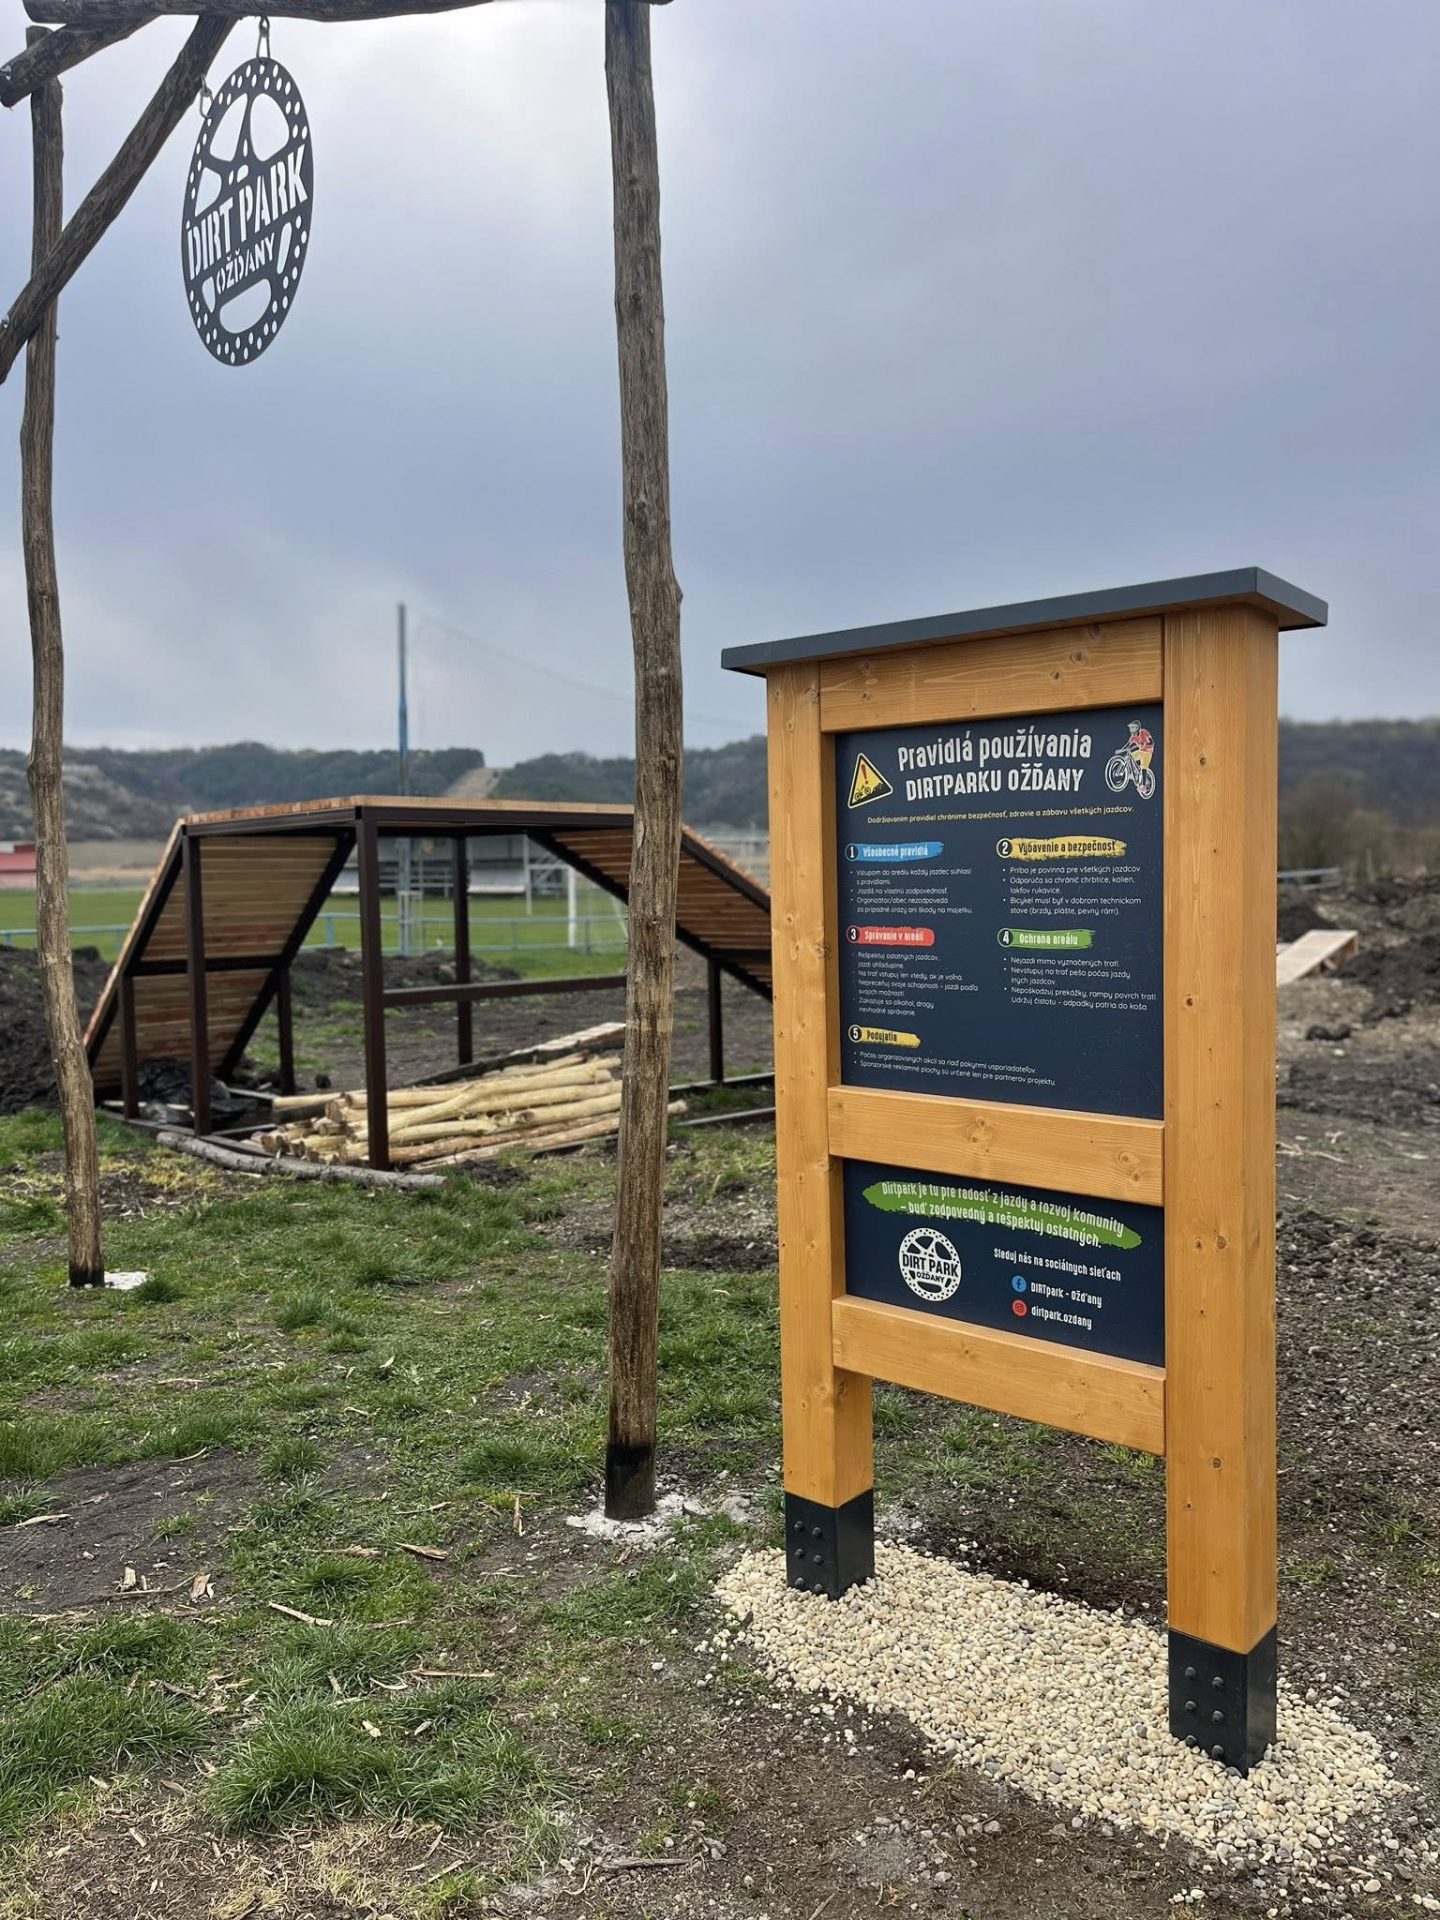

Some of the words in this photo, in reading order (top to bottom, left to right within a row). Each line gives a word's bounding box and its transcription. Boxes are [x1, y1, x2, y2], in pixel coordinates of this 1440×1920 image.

[187, 197, 233, 280] DIRT
[239, 144, 308, 242] PARK
[216, 232, 275, 294] OŽĎANY
[898, 730, 972, 772] Pravidlá
[980, 725, 1092, 768] používania
[906, 770, 1001, 801] DIRTPARKU
[1008, 762, 1084, 791] OŽĎANY
[937, 812, 966, 820] chránime
[1070, 807, 1102, 815] všetkých
[1103, 806, 1134, 814] jazdcov.
[850, 847, 854, 858] 1
[900, 844, 928, 858] pravidlá
[1002, 842, 1008, 854] 2
[1061, 844, 1065, 852] a
[1068, 840, 1115, 854] bezpečnosť
[1030, 867, 1036, 875] je
[1010, 897, 1033, 905] Bicykel
[1078, 907, 1099, 915] pevný
[851, 929, 856, 940] 3
[1003, 931, 1009, 943] 4
[1020, 933, 1050, 944] Ochrana
[1053, 933, 1078, 945] areálu
[1058, 959, 1102, 967] vyznačených
[1011, 967, 1043, 975] Nevstupuj
[1111, 970, 1130, 979] jazdy
[1011, 987, 1053, 996] Nepoškodzuj
[1063, 1000, 1093, 1009] odpadky
[853, 1028, 858, 1039] 5
[867, 1030, 897, 1043] Podujatia
[960, 1060, 987, 1069] pokynmi
[921, 1066, 941, 1075] plochy
[950, 1069, 971, 1077] určené
[994, 1073, 1026, 1082] partnerov
[1027, 1076, 1056, 1086] projektu.
[882, 1182, 917, 1198] Dirtpark
[918, 1182, 927, 1198] je
[929, 1184, 938, 1196] tu
[941, 1186, 956, 1200] pre
[959, 1188, 990, 1202] radosť
[993, 1193, 998, 1204] z
[1001, 1191, 1027, 1211] jazdy
[1030, 1200, 1036, 1211] a
[1040, 1201, 1071, 1222] rozvoj
[1074, 1208, 1124, 1237] komunity
[908, 1202, 927, 1214] buď
[930, 1204, 985, 1224] zodpovedný
[989, 1212, 994, 1222] a
[996, 1212, 1043, 1235] rešpektuj
[1047, 1223, 1101, 1248] ostatných.
[903, 1254, 926, 1270] DIRT
[929, 1258, 958, 1277] PARK
[994, 1248, 1017, 1263] Sleduj
[1018, 1251, 1032, 1264] nás
[1034, 1257, 1043, 1267] na
[1045, 1258, 1088, 1276] sociálnych
[1089, 1266, 1121, 1282] sieťach
[1031, 1282, 1064, 1299] DIRTpark
[1032, 1306, 1092, 1330] dirtpark.ozdany
